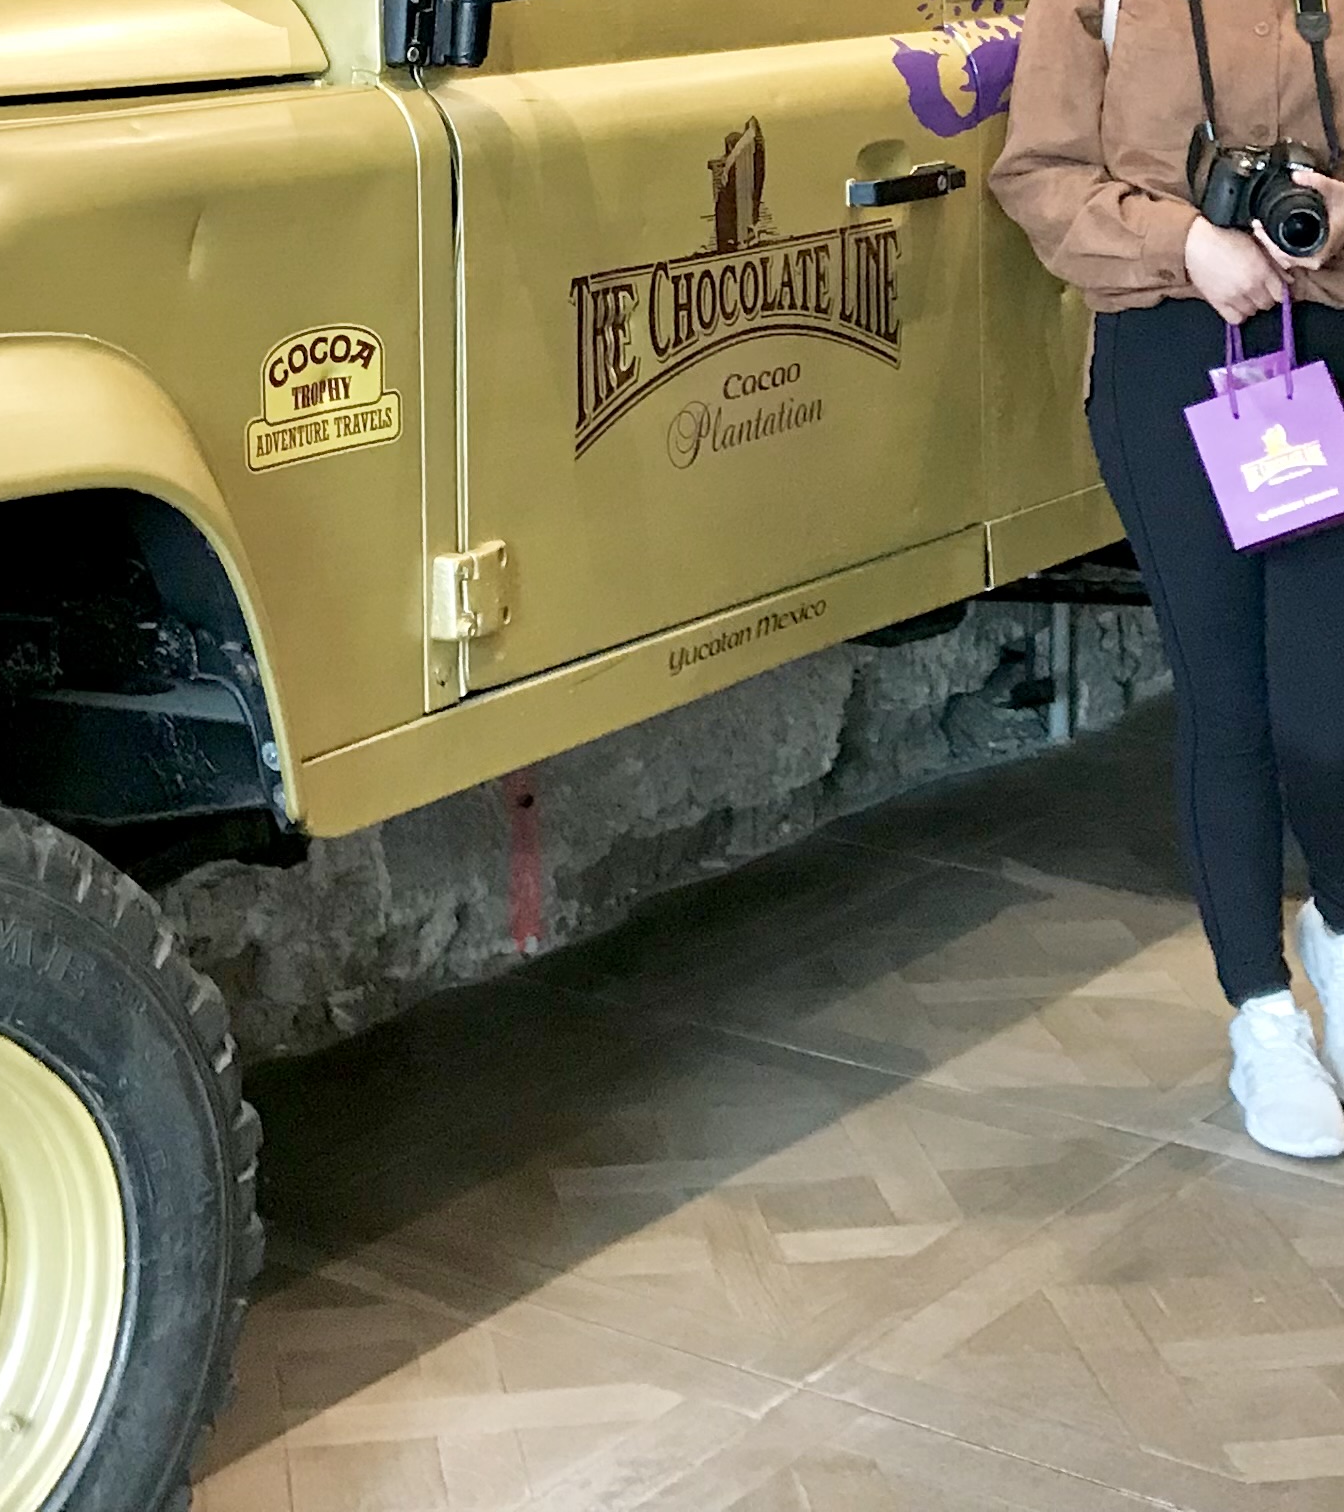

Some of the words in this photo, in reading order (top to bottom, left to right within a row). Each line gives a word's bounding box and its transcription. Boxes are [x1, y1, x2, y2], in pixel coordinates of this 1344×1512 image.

[569, 276, 641, 434] THE
[648, 261, 831, 363] CHOCOLATE
[838, 227, 902, 352] LINE
[268, 334, 378, 388] COCOA
[722, 362, 801, 400] Cacao
[291, 375, 353, 411] TROPHY
[255, 418, 330, 458] ADVENTURE
[333, 406, 393, 438] TRAVELS
[666, 398, 824, 469] Plantation
[755, 598, 828, 640] Mexico
